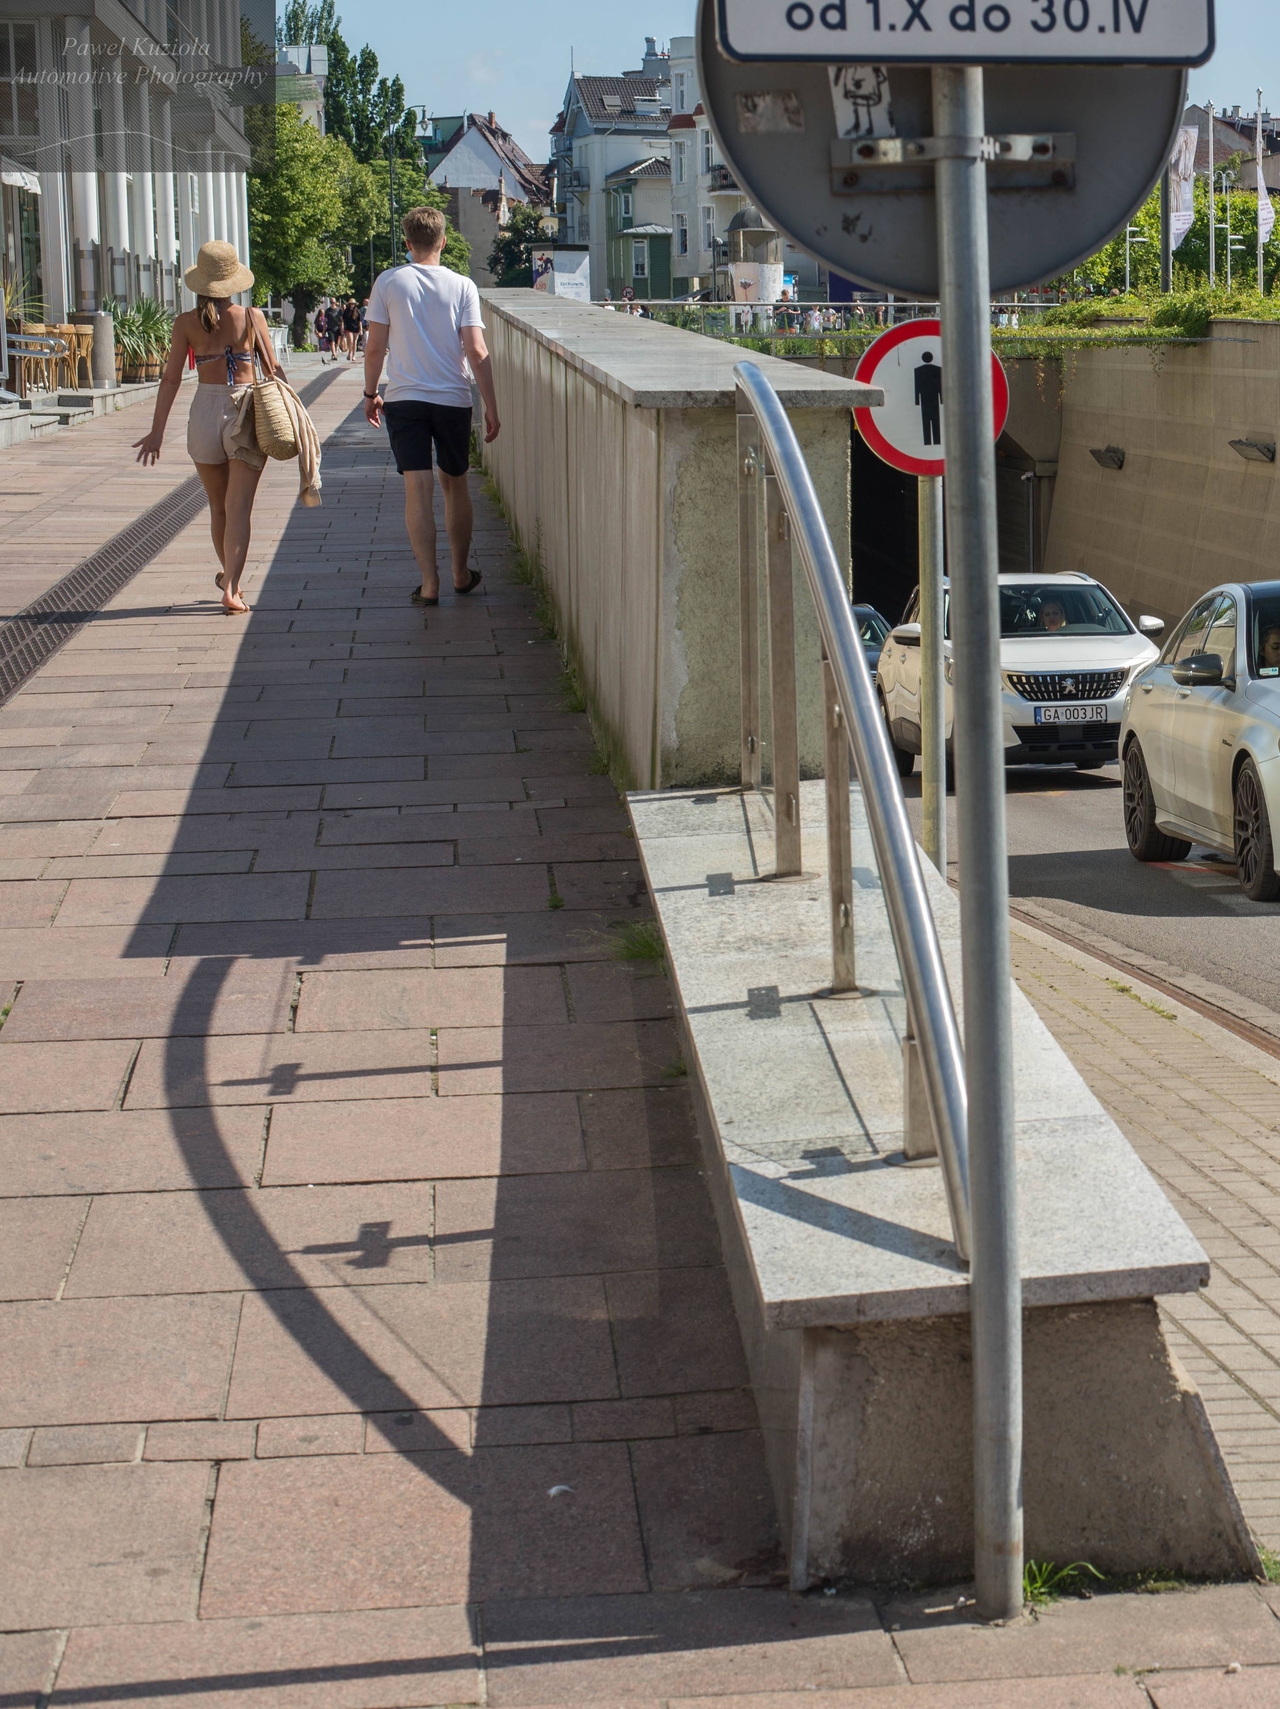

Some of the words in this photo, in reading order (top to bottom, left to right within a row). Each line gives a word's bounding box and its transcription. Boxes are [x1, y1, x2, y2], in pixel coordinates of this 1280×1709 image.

[786, 0, 847, 31] od
[866, 0, 932, 32] 1.X
[949, 0, 1011, 32] do
[1030, 0, 1149, 34] 30.IV
[1043, 708, 1060, 721] GA
[1064, 706, 1103, 720] 003JR
